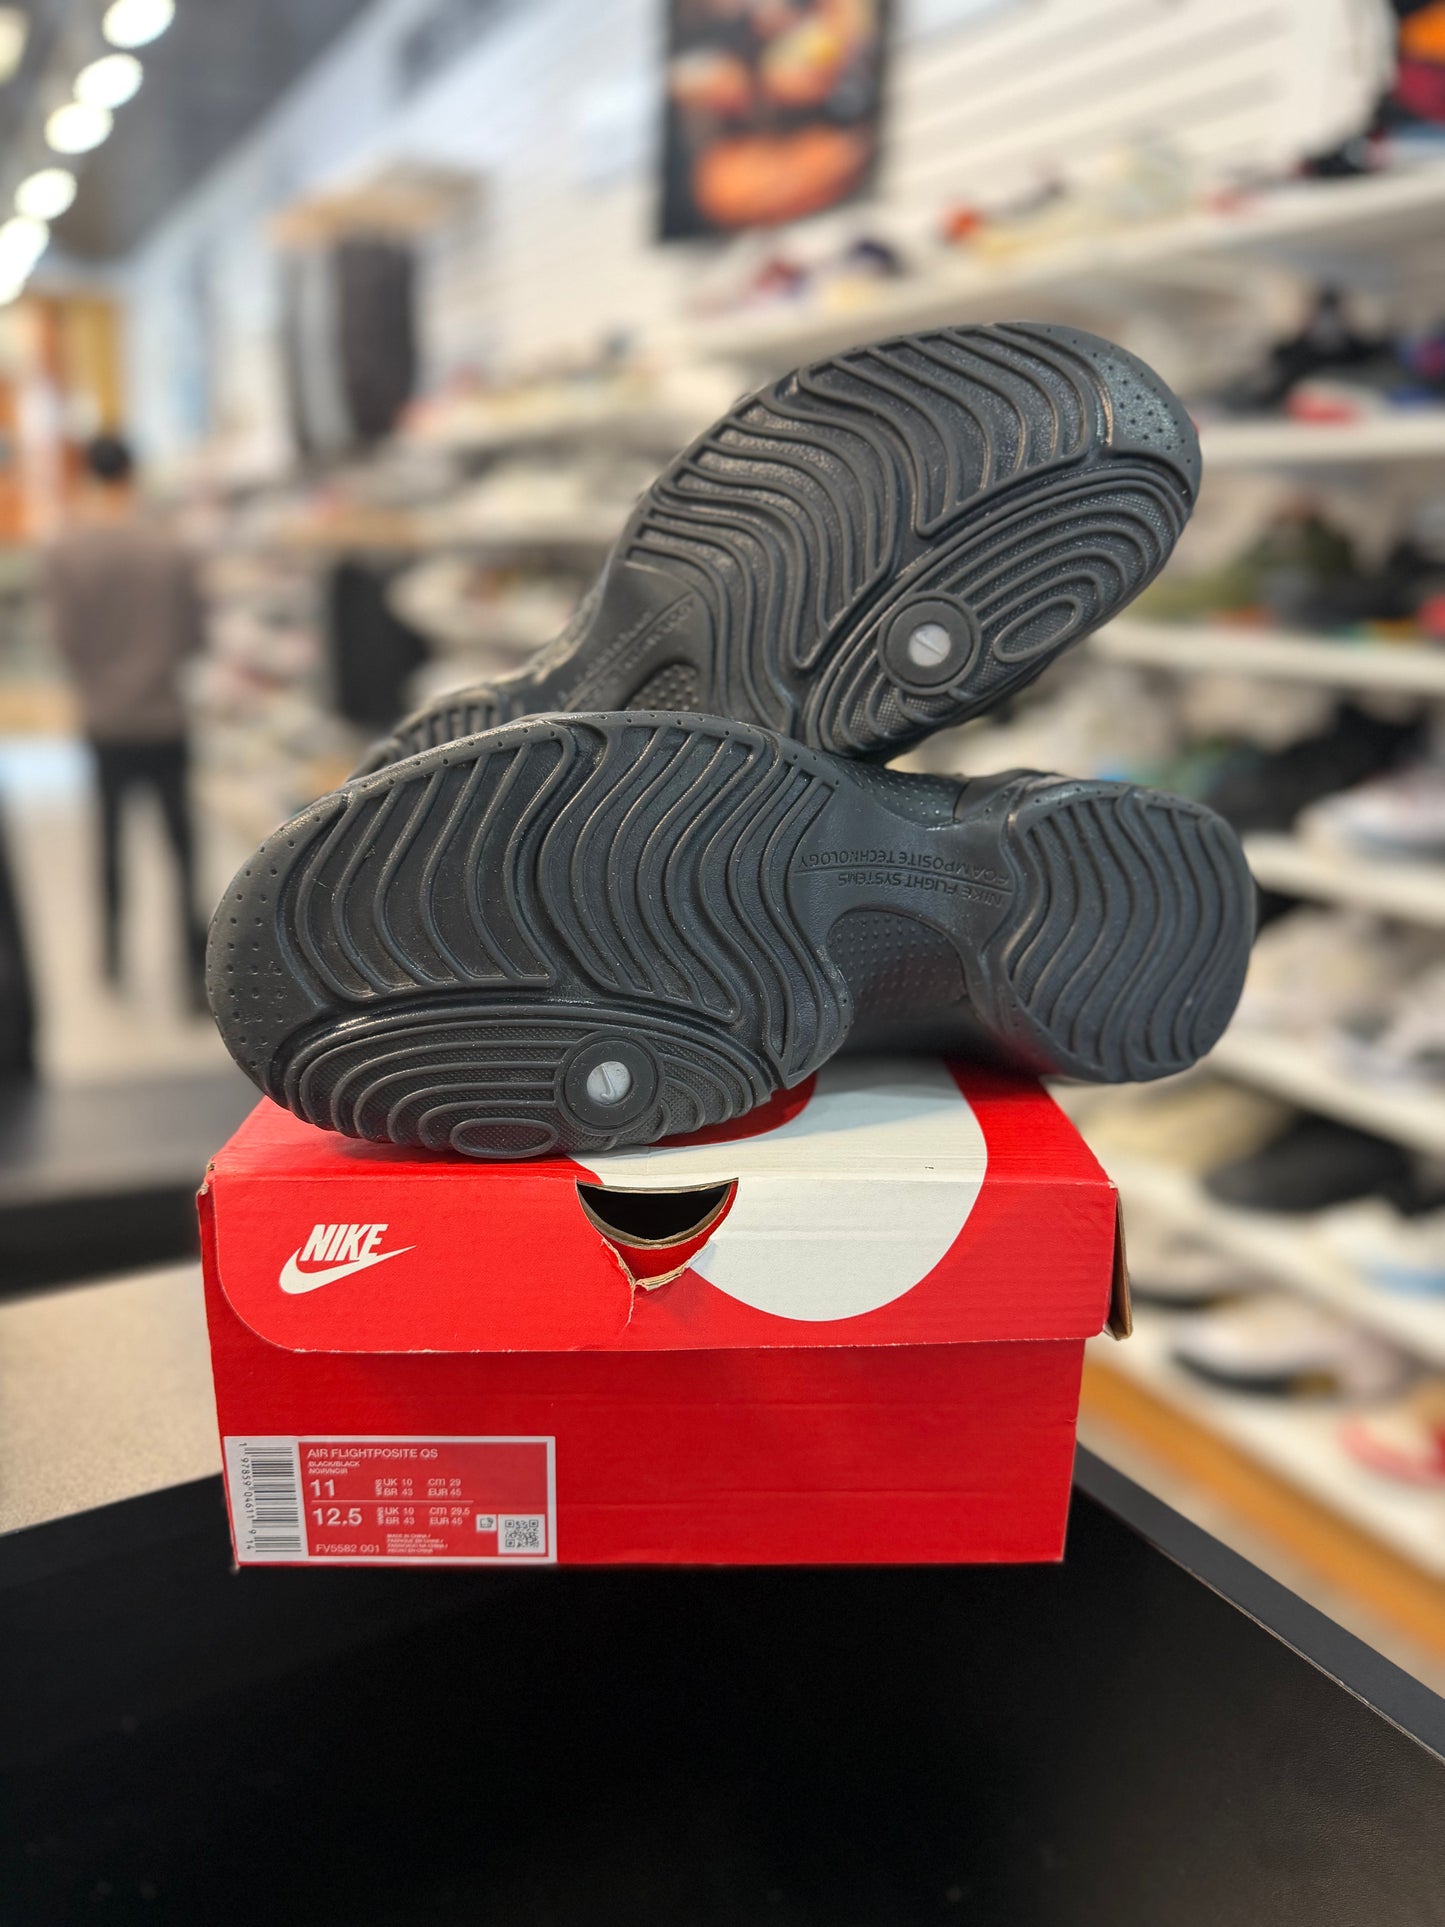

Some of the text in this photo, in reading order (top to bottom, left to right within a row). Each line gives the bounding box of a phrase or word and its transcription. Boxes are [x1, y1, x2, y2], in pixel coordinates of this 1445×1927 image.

[799, 849, 894, 868] TECHNOLOGY
[837, 871, 901, 887] SYSTEMS
[905, 875, 958, 896] FLIGHT
[300, 1224, 389, 1262] NIKE
[307, 1448, 438, 1459] AIR FLIGHTPOSITE QS
[308, 1460, 361, 1468] BLACK/BLACK
[383, 1478, 413, 1486] UK 10
[449, 1478, 462, 1486] 29
[310, 1479, 335, 1498] 11
[383, 1488, 414, 1496] BR 43
[428, 1488, 462, 1496] EUR 45
[385, 1507, 415, 1515] UK 10
[450, 1507, 471, 1515] 29.5
[312, 1507, 363, 1526] 12.5
[385, 1517, 415, 1525] BR 43
[430, 1517, 450, 1525] EUR
[315, 1543, 358, 1553] FV5582
[360, 1543, 381, 1553] 001
